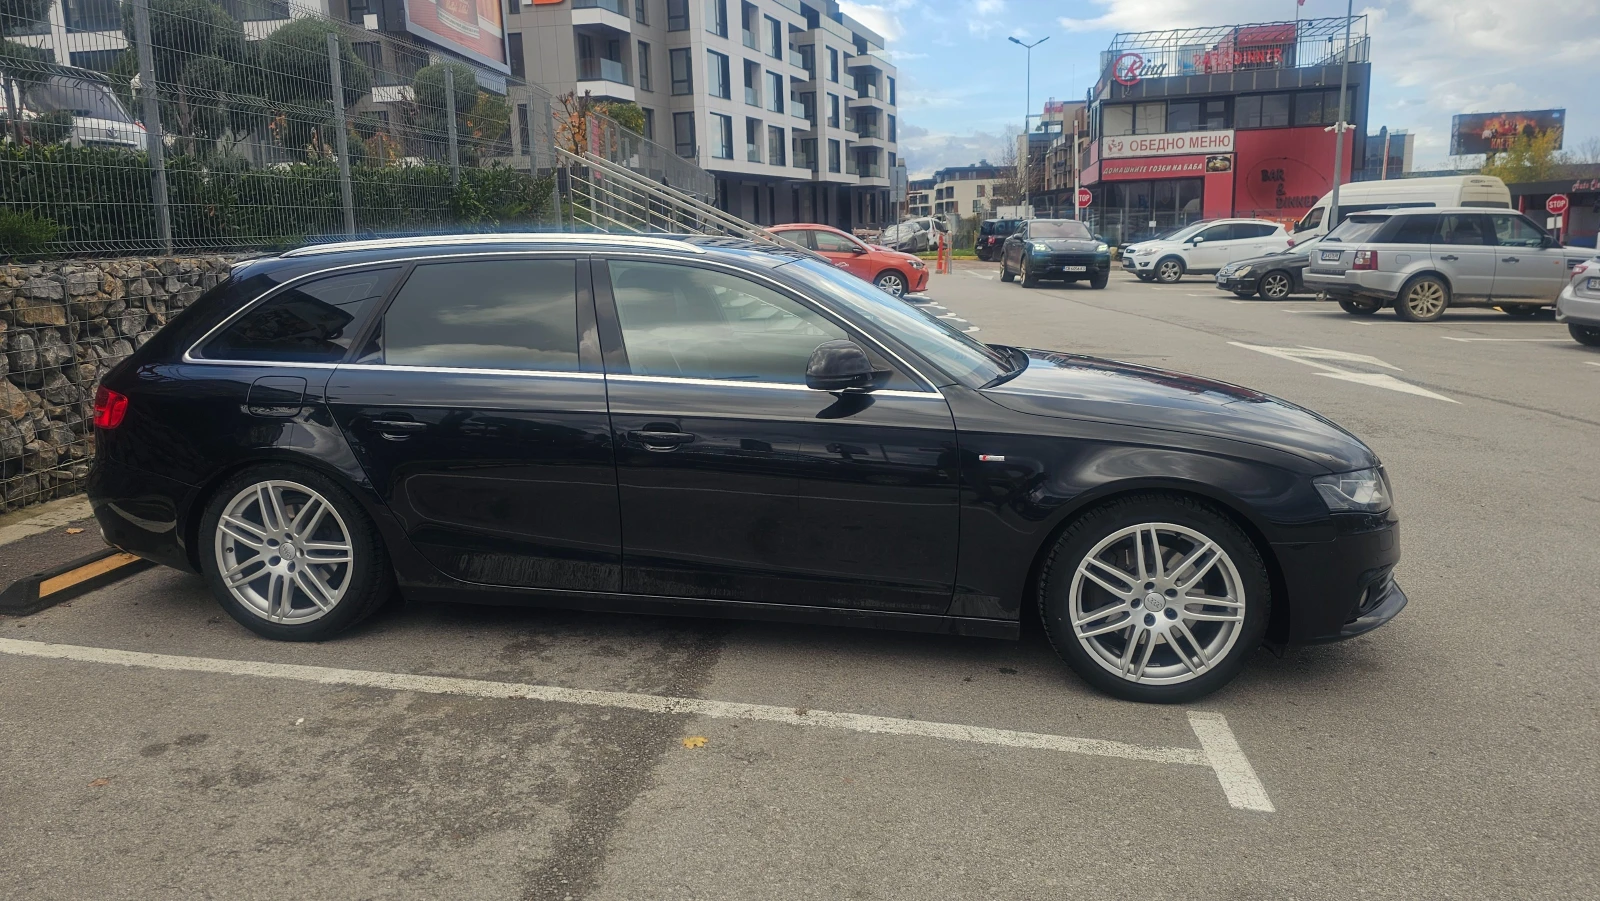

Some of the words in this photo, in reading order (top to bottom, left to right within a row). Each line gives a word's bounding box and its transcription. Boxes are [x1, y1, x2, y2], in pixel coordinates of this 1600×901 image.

[1234, 48, 1283, 65] DINNER
[1129, 137, 1185, 152] ОБЕДНО
[1189, 135, 1231, 149] МЕНЮ
[1103, 165, 1147, 174] ДОМАШНИТЕ
[1148, 164, 1171, 173] ГОЗБИ
[1183, 163, 1203, 171] БАБА
[1261, 169, 1285, 182] BAR
[1572, 180, 1589, 192] Auto
[1078, 194, 1090, 202] TOP
[1548, 199, 1566, 209] STOP
